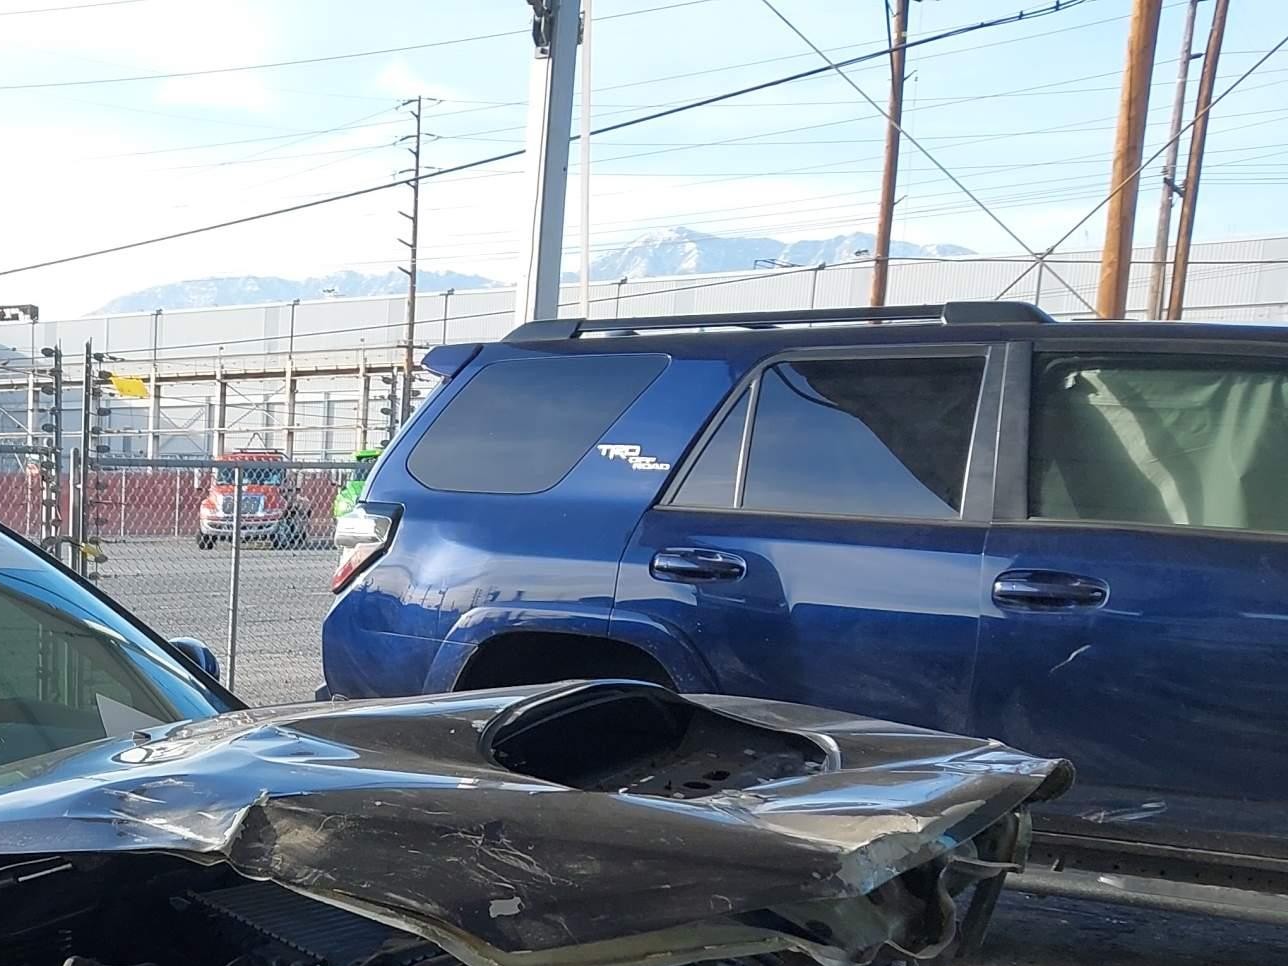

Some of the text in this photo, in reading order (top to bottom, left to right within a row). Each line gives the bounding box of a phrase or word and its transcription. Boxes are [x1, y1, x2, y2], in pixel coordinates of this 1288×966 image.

[597, 444, 641, 460] TRD
[628, 456, 657, 465] OFF
[632, 463, 671, 471] ROAD
